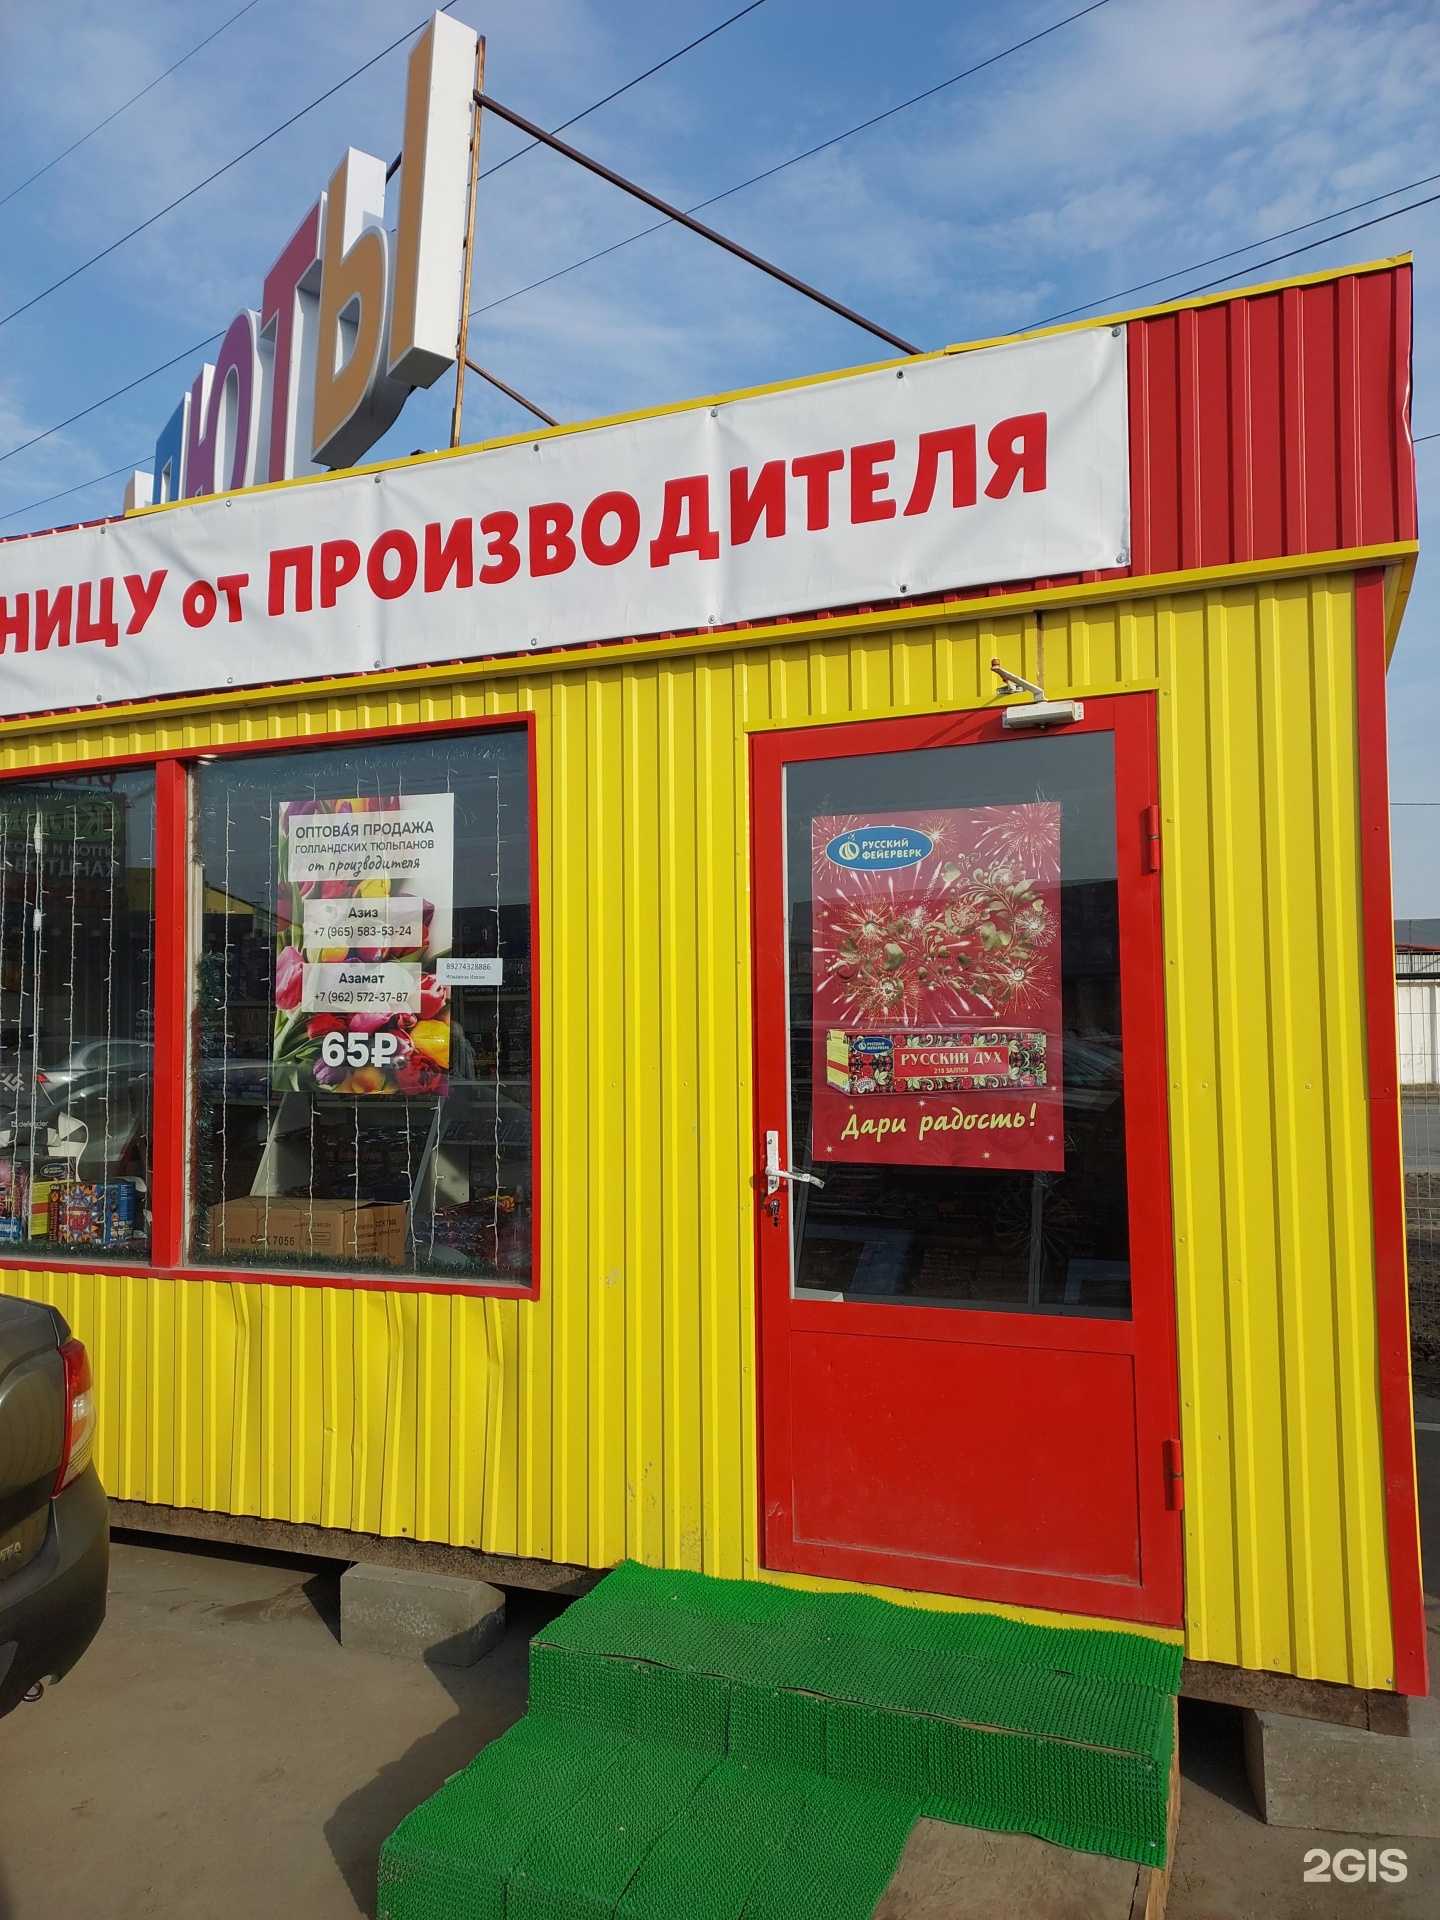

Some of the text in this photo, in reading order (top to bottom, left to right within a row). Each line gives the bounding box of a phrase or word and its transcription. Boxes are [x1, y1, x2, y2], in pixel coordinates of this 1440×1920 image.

[182, 574, 249, 628] от
[268, 412, 1048, 617] ПРОИЗВОДИТЕЛЯ
[295, 821, 435, 839] ОПТОВАЯ ПРОДАЖА
[295, 839, 434, 855] ГОЛЛАНДСКИХ ТЮЛЬПАНОВ
[862, 838, 909, 850] РУССКИЙ
[861, 848, 922, 860] ФЕЙЕРВЕРК
[308, 855, 421, 878] от производителя
[348, 907, 379, 919] Азиз
[313, 925, 412, 940] +7 (965) 583-53-24
[338, 972, 385, 984] Азамат
[314, 990, 409, 1004] +7 (962) 572-37-87
[901, 1050, 1003, 1066] РУССКИЙ ДУХ
[840, 1102, 1038, 1143] Дари радость!
